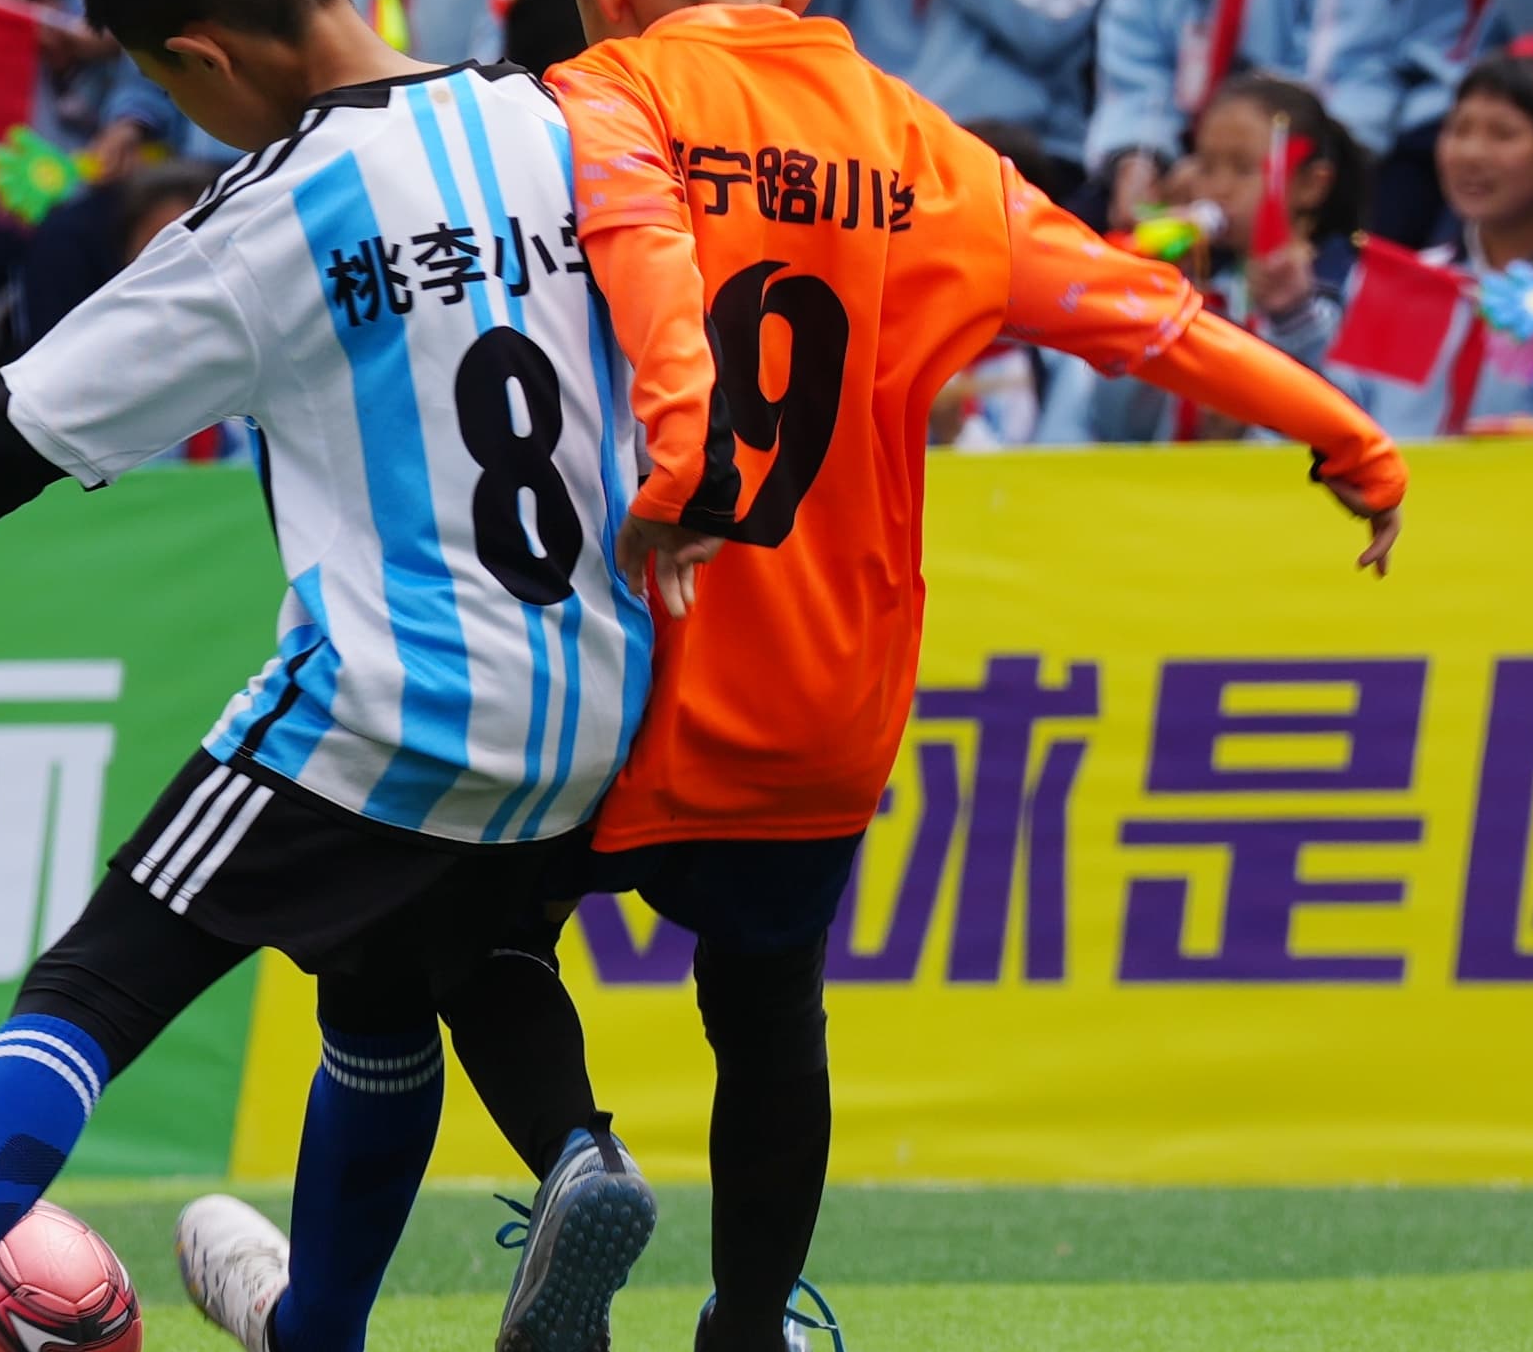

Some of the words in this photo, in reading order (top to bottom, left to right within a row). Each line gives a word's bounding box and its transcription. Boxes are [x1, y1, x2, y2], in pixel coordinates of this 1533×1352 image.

[672, 138, 914, 233] 宁路小
[455, 326, 583, 605] 8
[709, 260, 849, 548] 9
